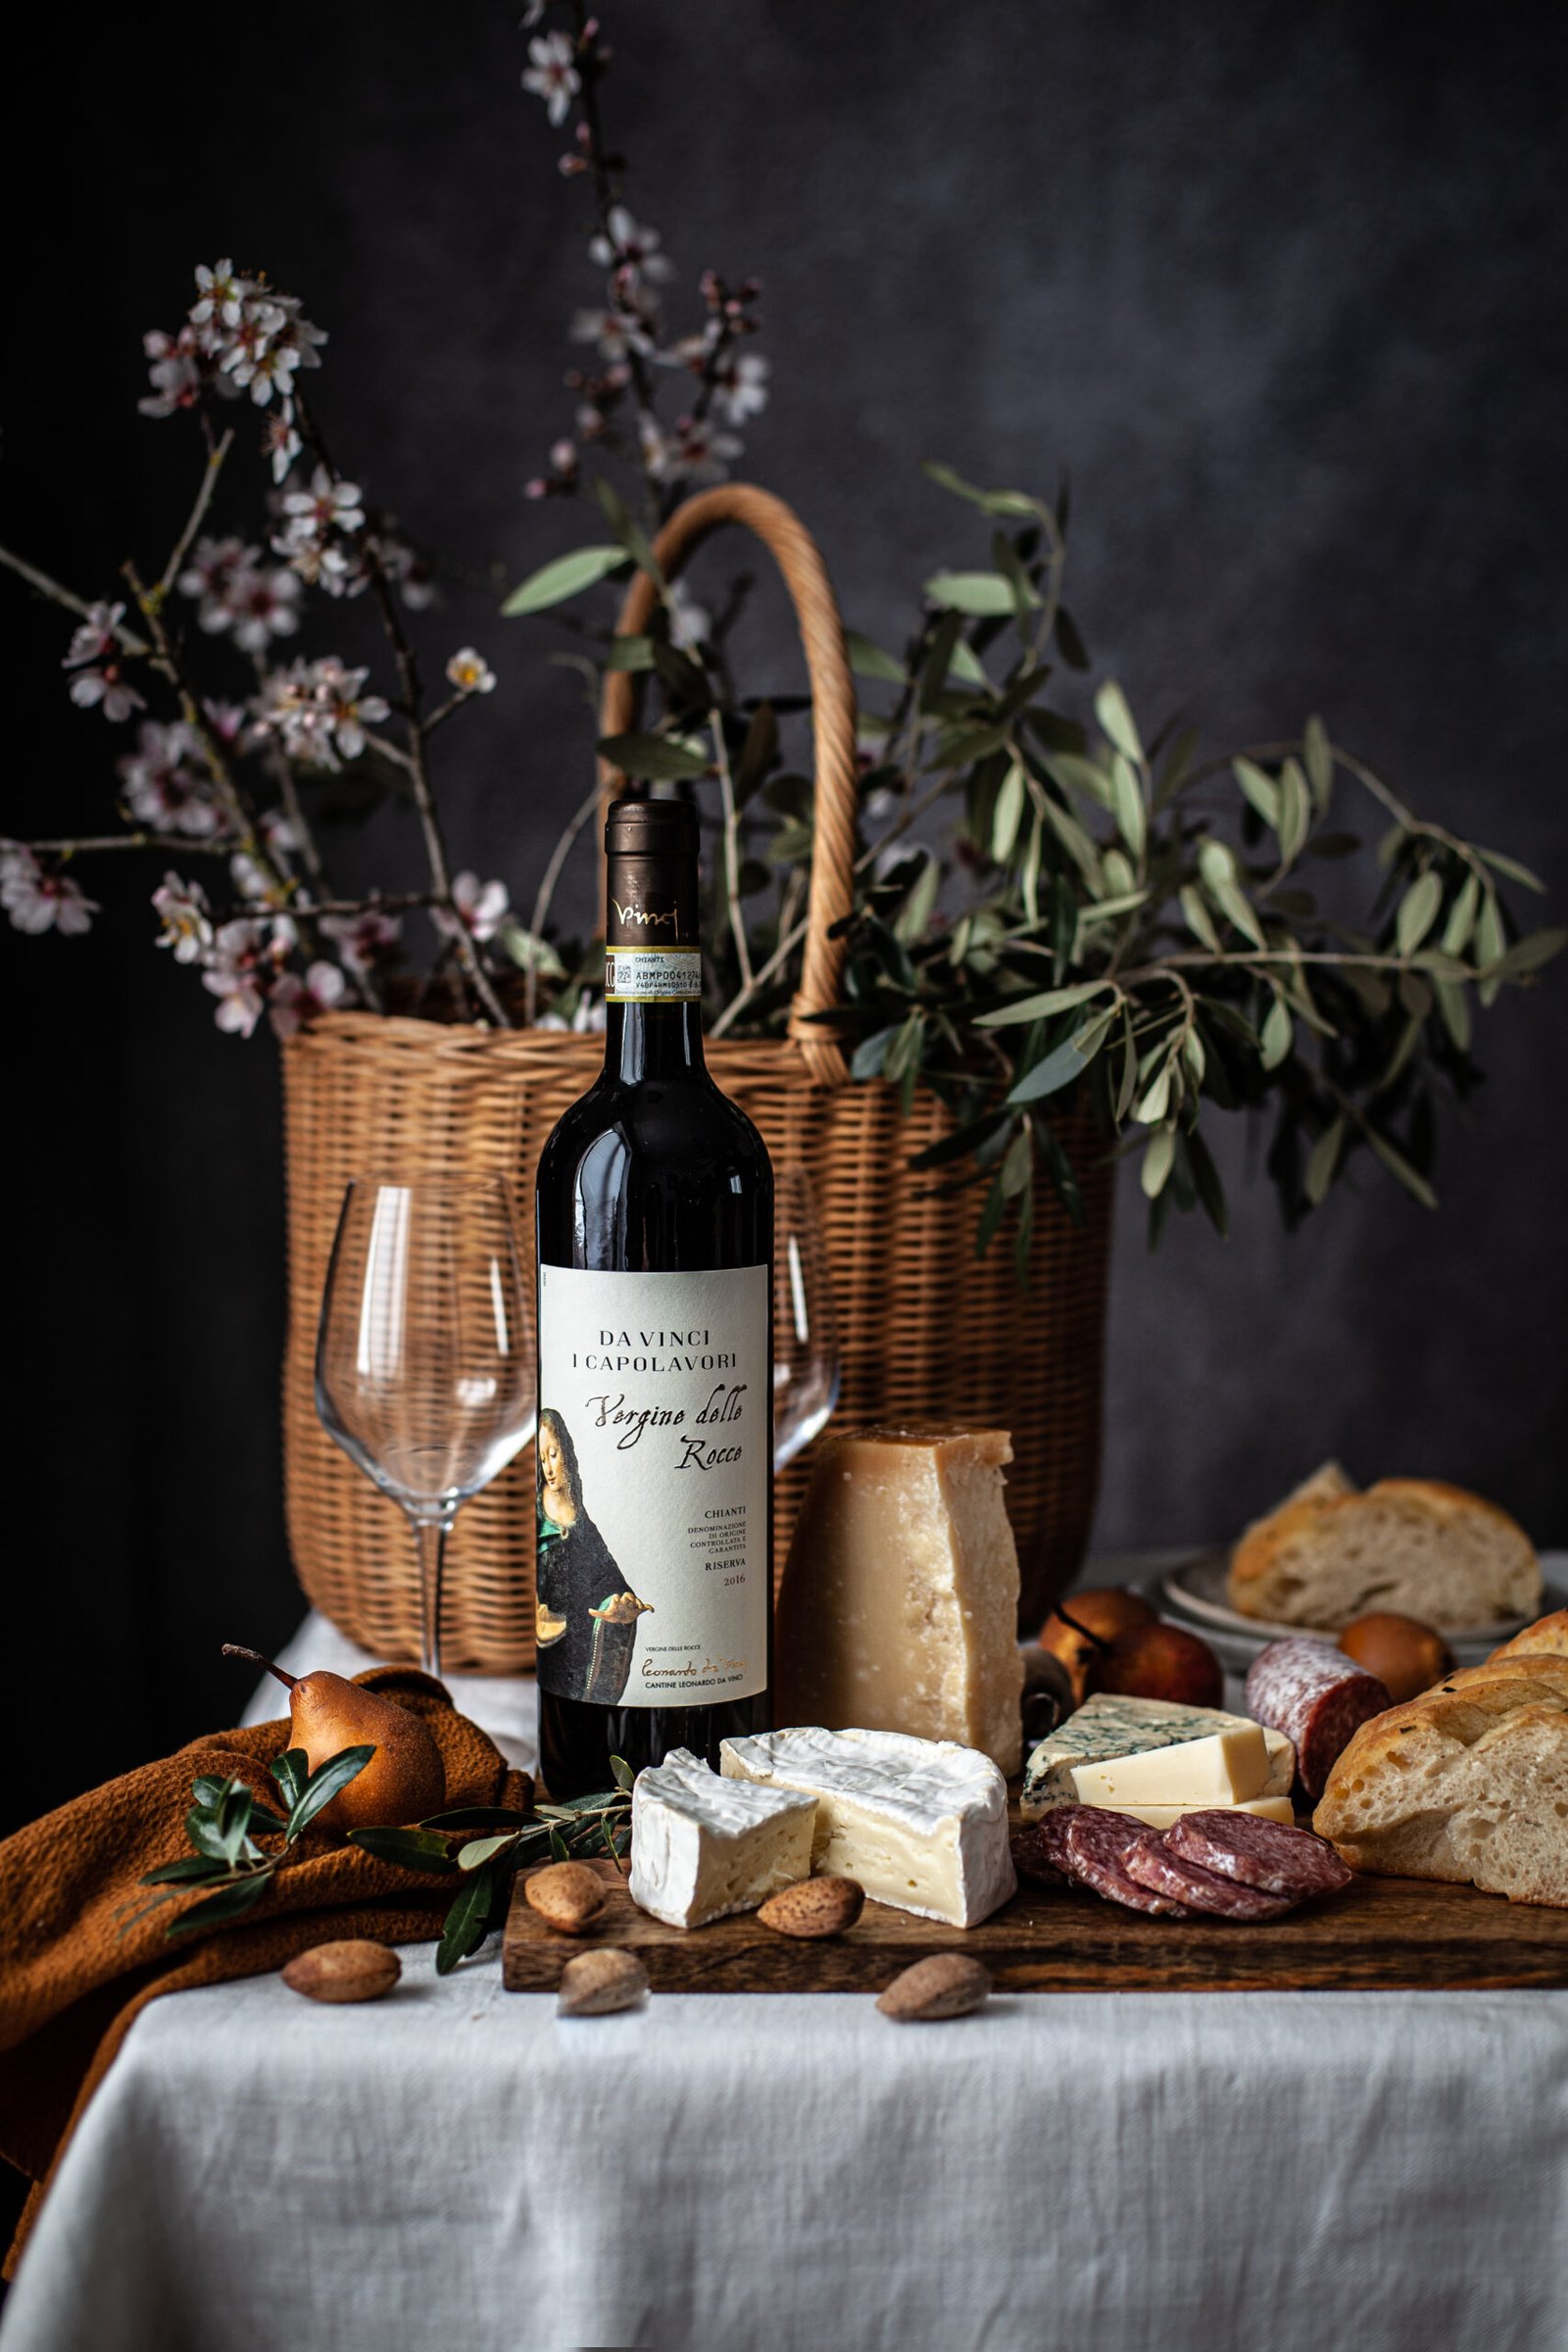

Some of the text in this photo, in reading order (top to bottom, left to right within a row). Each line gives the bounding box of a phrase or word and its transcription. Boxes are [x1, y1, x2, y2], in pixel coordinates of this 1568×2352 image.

[600, 1330, 710, 1348] DA VINCI
[572, 1353, 736, 1372] I CAPOLAVORI
[585, 1383, 748, 1450] Vergine delle
[674, 1435, 743, 1470] Rocce
[704, 1505, 746, 1519] CHIANTI
[688, 1521, 746, 1534] DENOMINAZIONE
[719, 1529, 746, 1539] ORIGINE
[690, 1538, 741, 1548] CONTROLLATA
[709, 1544, 746, 1554] GARANTITA
[705, 1558, 746, 1571] RISERVA
[723, 1574, 746, 1586] 2016
[678, 1678, 716, 1688] LEONARDO
